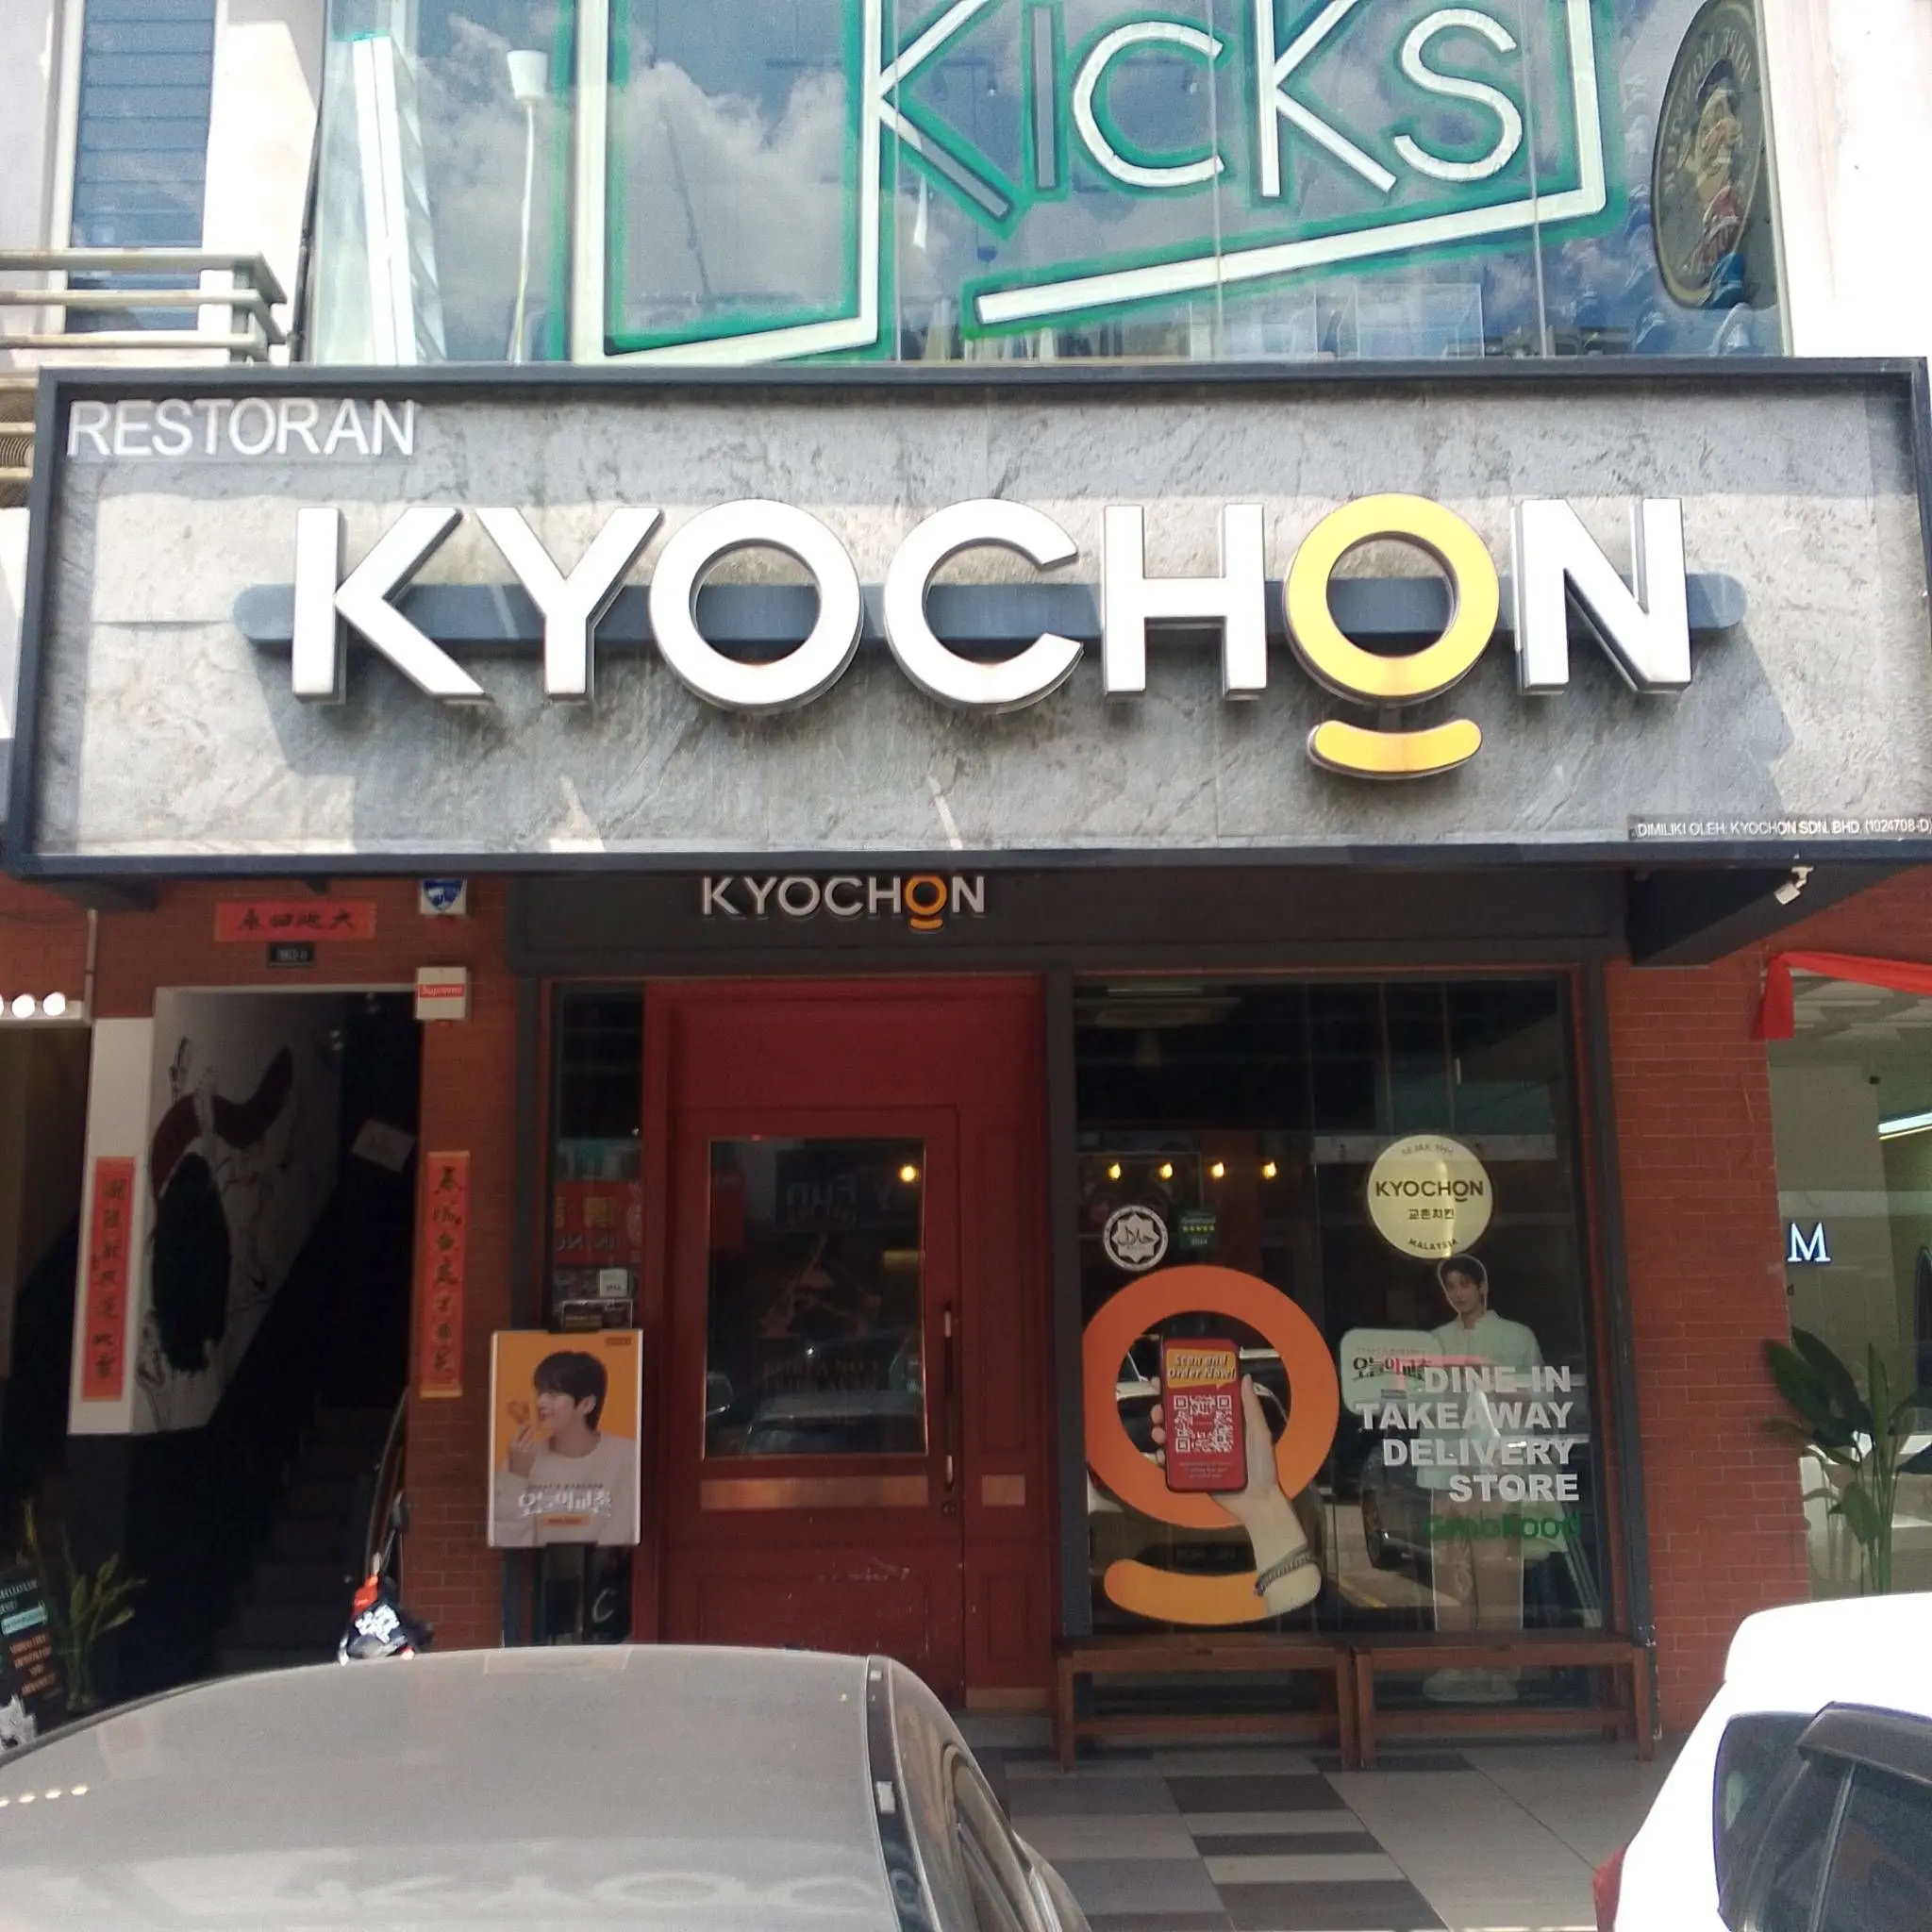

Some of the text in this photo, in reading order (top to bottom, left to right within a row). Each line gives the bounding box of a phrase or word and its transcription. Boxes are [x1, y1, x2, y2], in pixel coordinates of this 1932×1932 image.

[862, 0, 1524, 220] KICKS
[66, 397, 416, 458] RESTORAN
[290, 492, 1695, 780] KYOCHON
[1637, 822, 1686, 836] DIMILIKI
[1730, 821, 1797, 836] KYOCHON
[702, 875, 986, 929] KYOCHON
[1375, 1179, 1484, 1203] KYOCHON
[1408, 1237, 1459, 1251] MALAYSIA
[1787, 1221, 1831, 1263] M
[1168, 1367, 1201, 1380] Order
[1176, 1354, 1229, 1367] Scan and
[1424, 1365, 1518, 1393] DINE
[1532, 1365, 1572, 1392] IN
[1356, 1401, 1574, 1430] TAKEAWAY
[1383, 1438, 1574, 1466] DELIVERY
[1448, 1474, 1579, 1502] STORE
